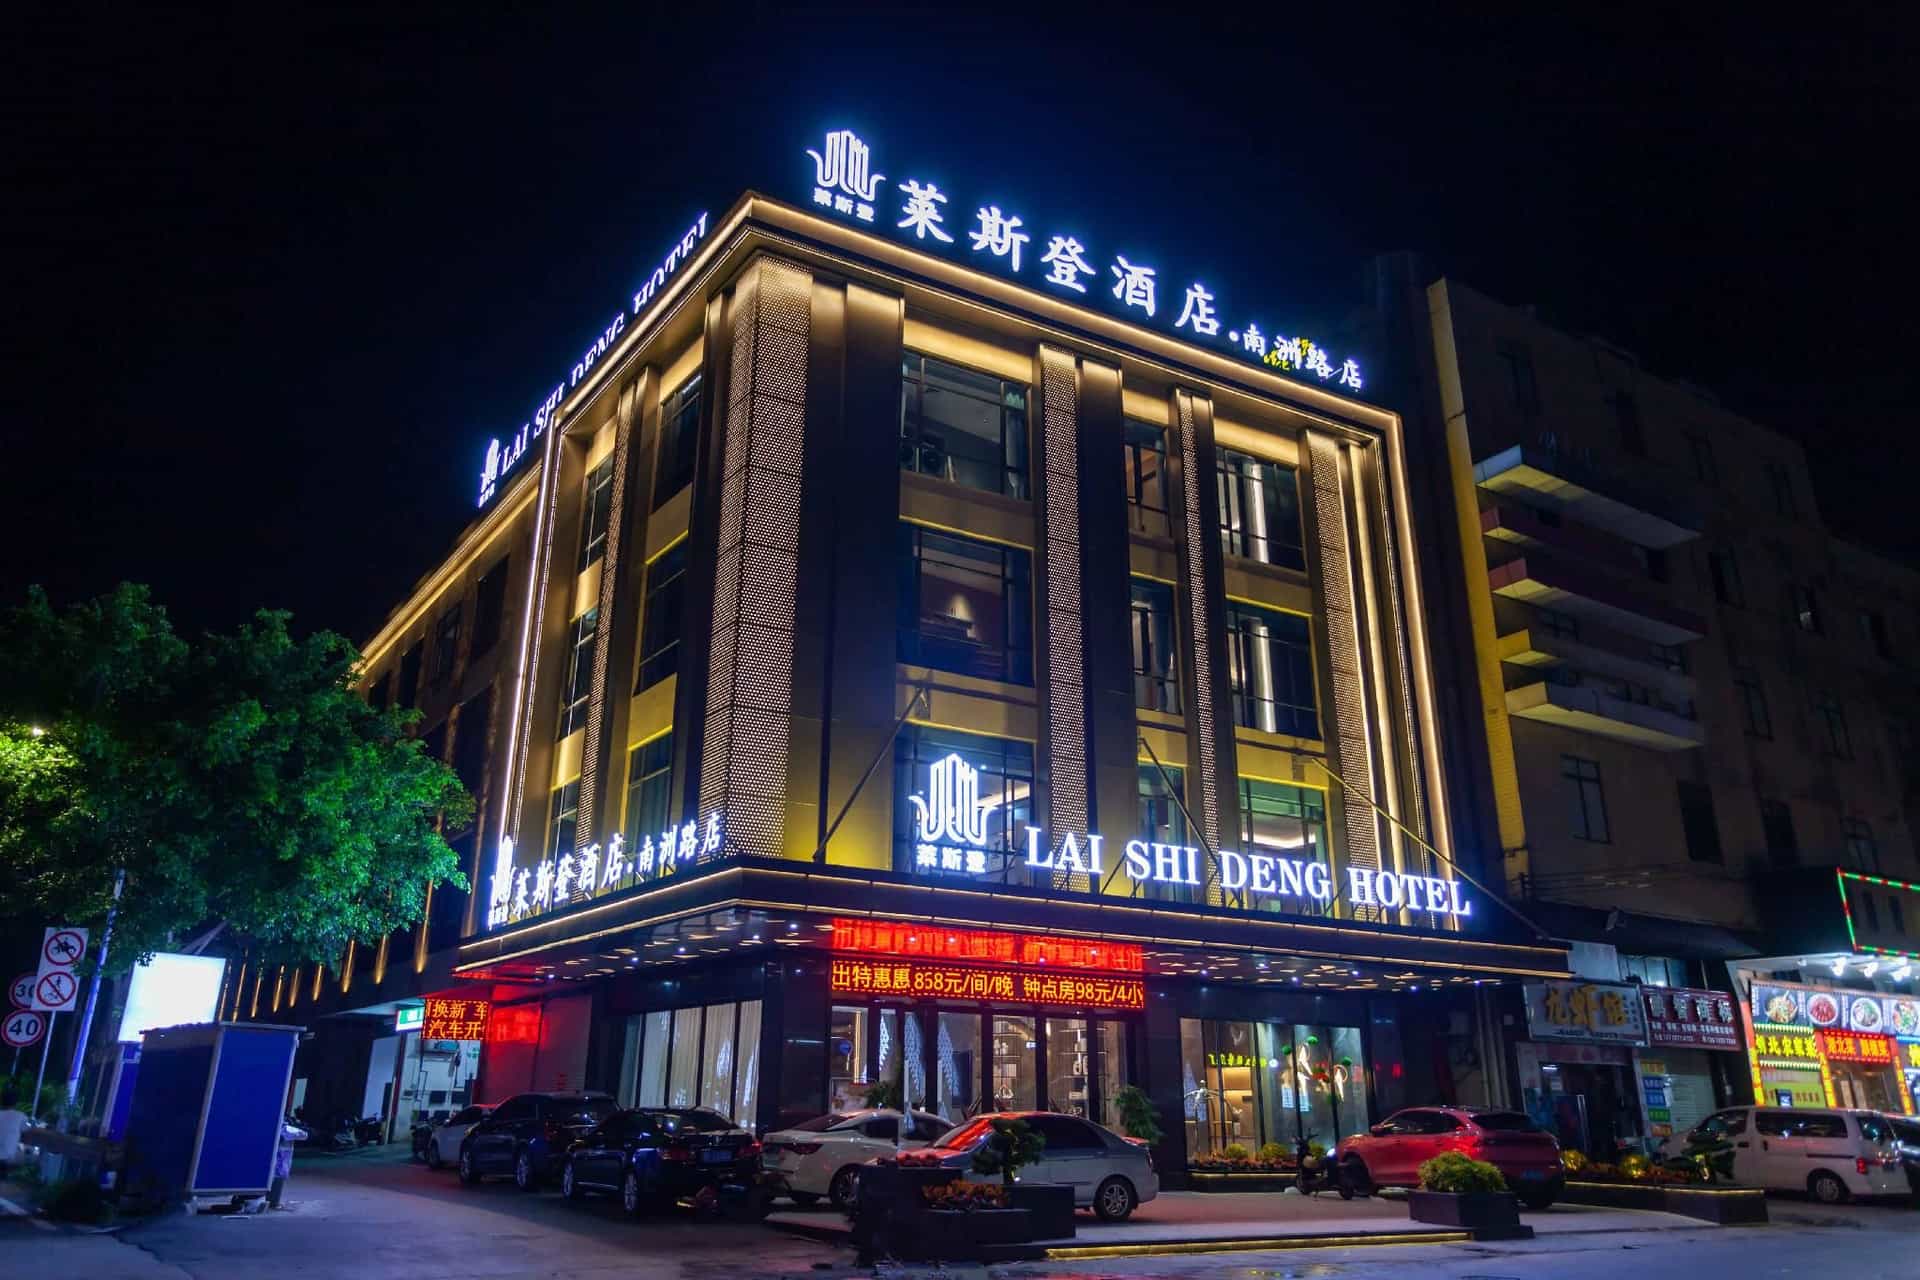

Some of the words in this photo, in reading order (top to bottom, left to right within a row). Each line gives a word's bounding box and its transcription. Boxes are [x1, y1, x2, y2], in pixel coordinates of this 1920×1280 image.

[1024, 826, 1104, 873] LAI
[1125, 840, 1200, 886] SHI
[1217, 850, 1333, 899] DENG
[1346, 866, 1473, 917] HOTEL
[8, 1018, 39, 1036] 40
